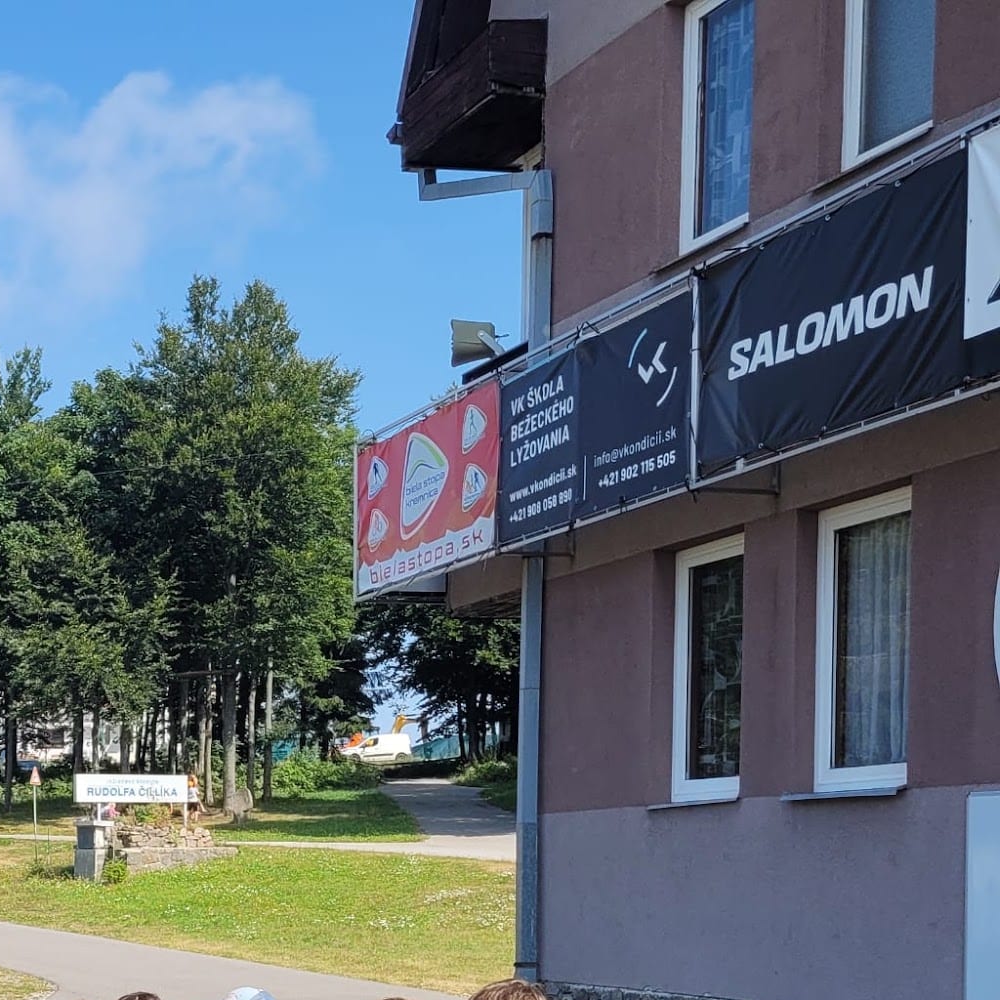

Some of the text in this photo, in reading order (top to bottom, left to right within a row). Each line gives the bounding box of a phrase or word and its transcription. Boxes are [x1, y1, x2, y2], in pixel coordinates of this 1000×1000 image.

[728, 265, 934, 381] SALOMON
[510, 375, 564, 416] VK ŠKOLA
[510, 396, 574, 442] BEŽECKÉHO
[510, 425, 570, 468] LYŽOVANIA
[593, 425, 677, 468] info@vkondicii.sk
[509, 463, 577, 503] www.vkondicii.sk
[598, 450, 676, 489] +421 902 115 505
[509, 506, 526, 523] +421
[527, 500, 541, 518] 908
[370, 528, 484, 585] bielastopa.sk
[87, 787, 136, 797] RUDOLFA
